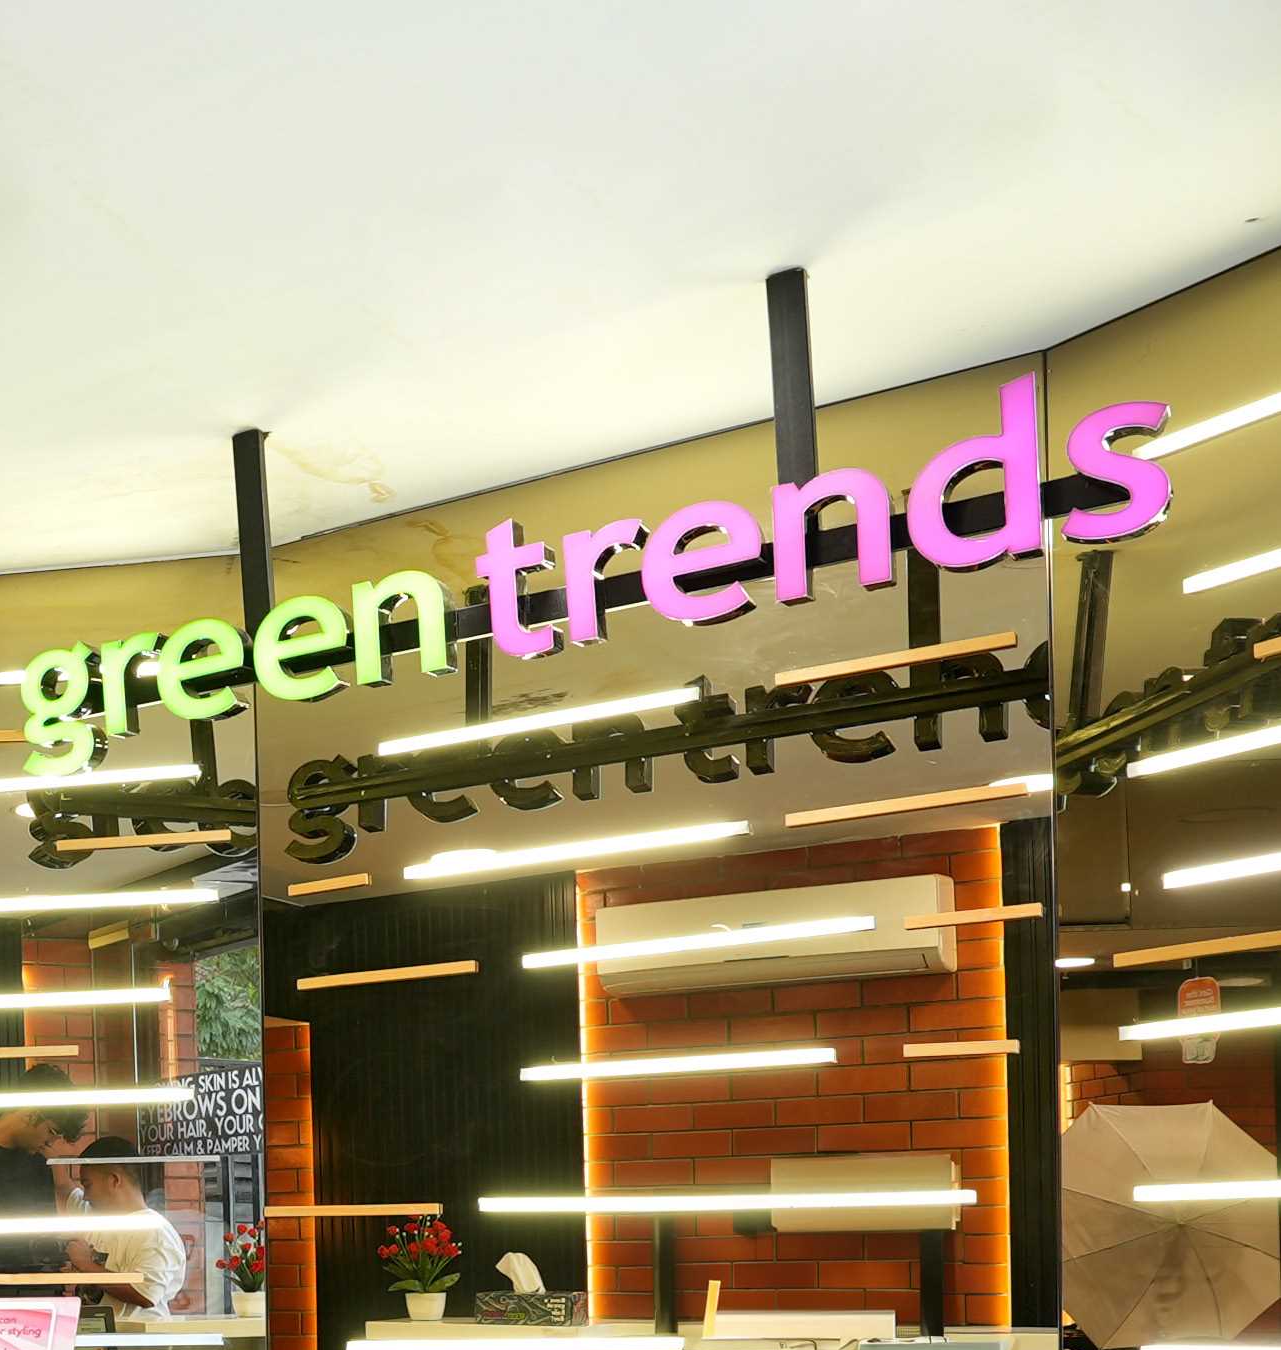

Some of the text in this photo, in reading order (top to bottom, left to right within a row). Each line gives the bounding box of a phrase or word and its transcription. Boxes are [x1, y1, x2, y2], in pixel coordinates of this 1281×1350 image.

[20, 372, 1173, 776] green trends
[198, 1071, 226, 1094] SKIN
[228, 1070, 238, 1089] IS
[177, 1118, 212, 1139] HAIR,
[215, 1114, 255, 1136] YOUR
[164, 1142, 194, 1156] CALM
[197, 1140, 205, 1155] &
[207, 1135, 250, 1154] PAMPER
[8, 1326, 42, 1338] styling
